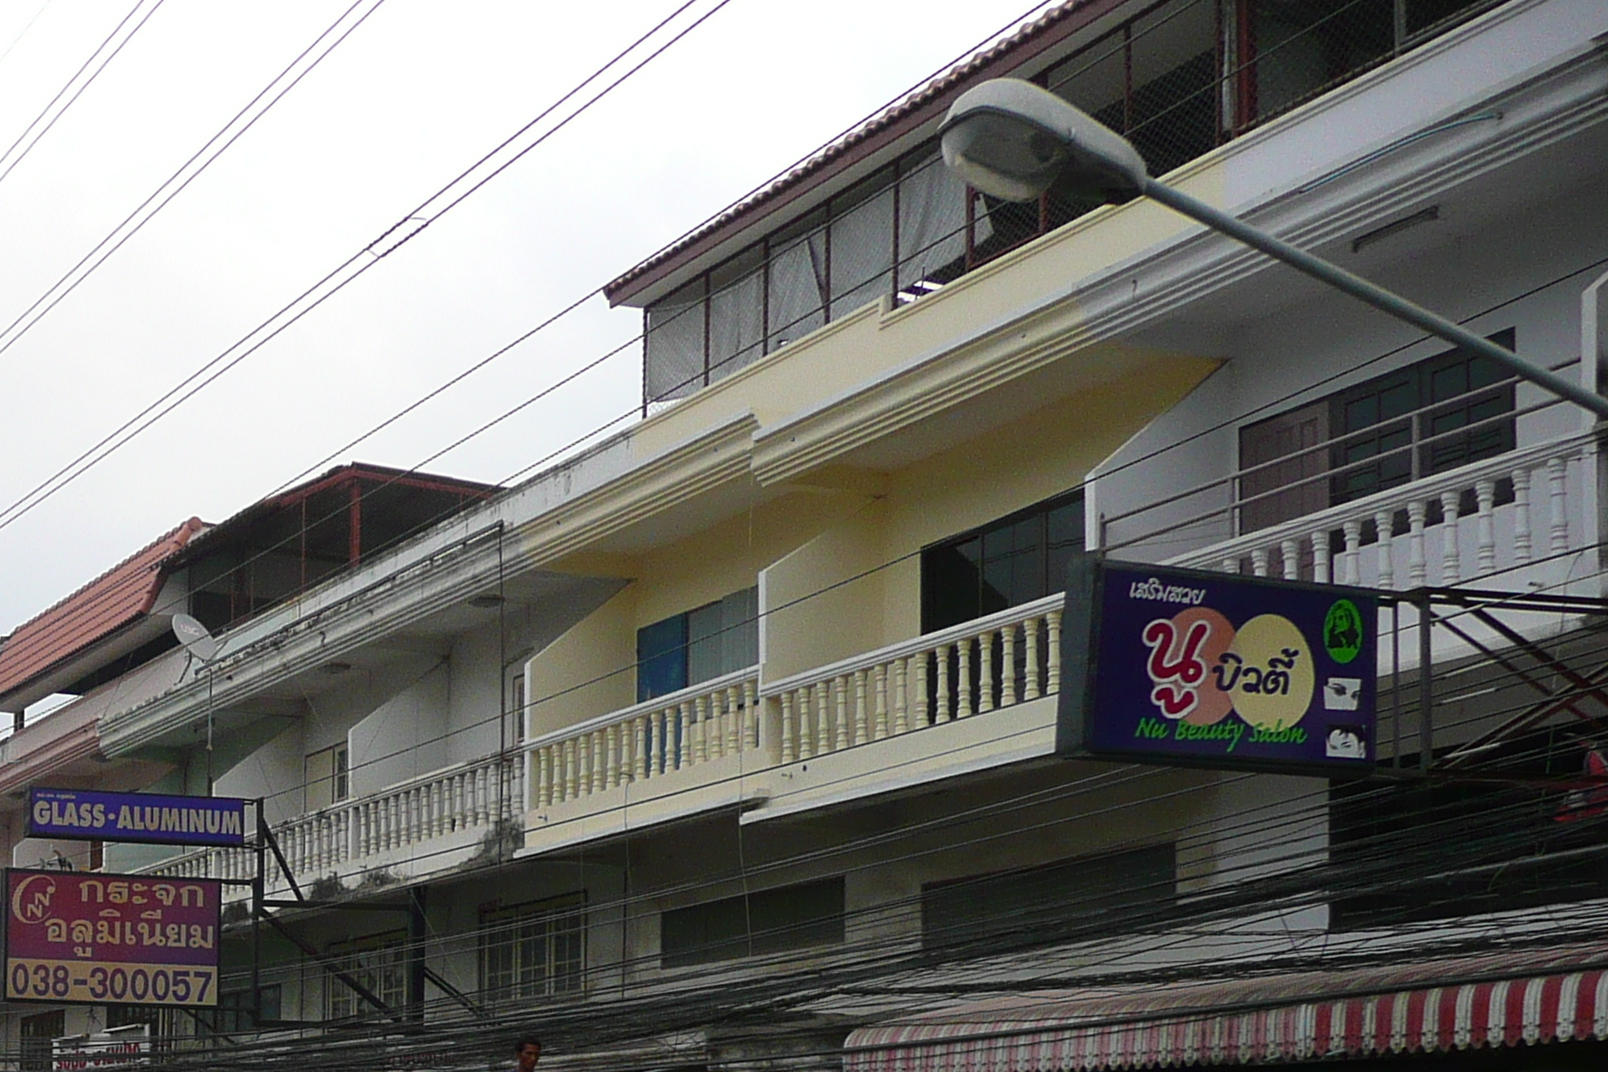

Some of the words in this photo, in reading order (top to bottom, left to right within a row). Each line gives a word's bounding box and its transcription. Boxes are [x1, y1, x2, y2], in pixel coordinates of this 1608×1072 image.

[1130, 577, 1206, 605] เสริมสวย
[1142, 618, 1212, 719] นู
[1212, 647, 1299, 695] บิวตี้
[1135, 717, 1168, 738] Nu
[1174, 720, 1246, 752] Beauty
[1249, 719, 1308, 744] Salon
[79, 880, 204, 907] กระจก
[45, 909, 214, 957] อลูมิเนียม
[12, 963, 212, 1002] 038-300057
